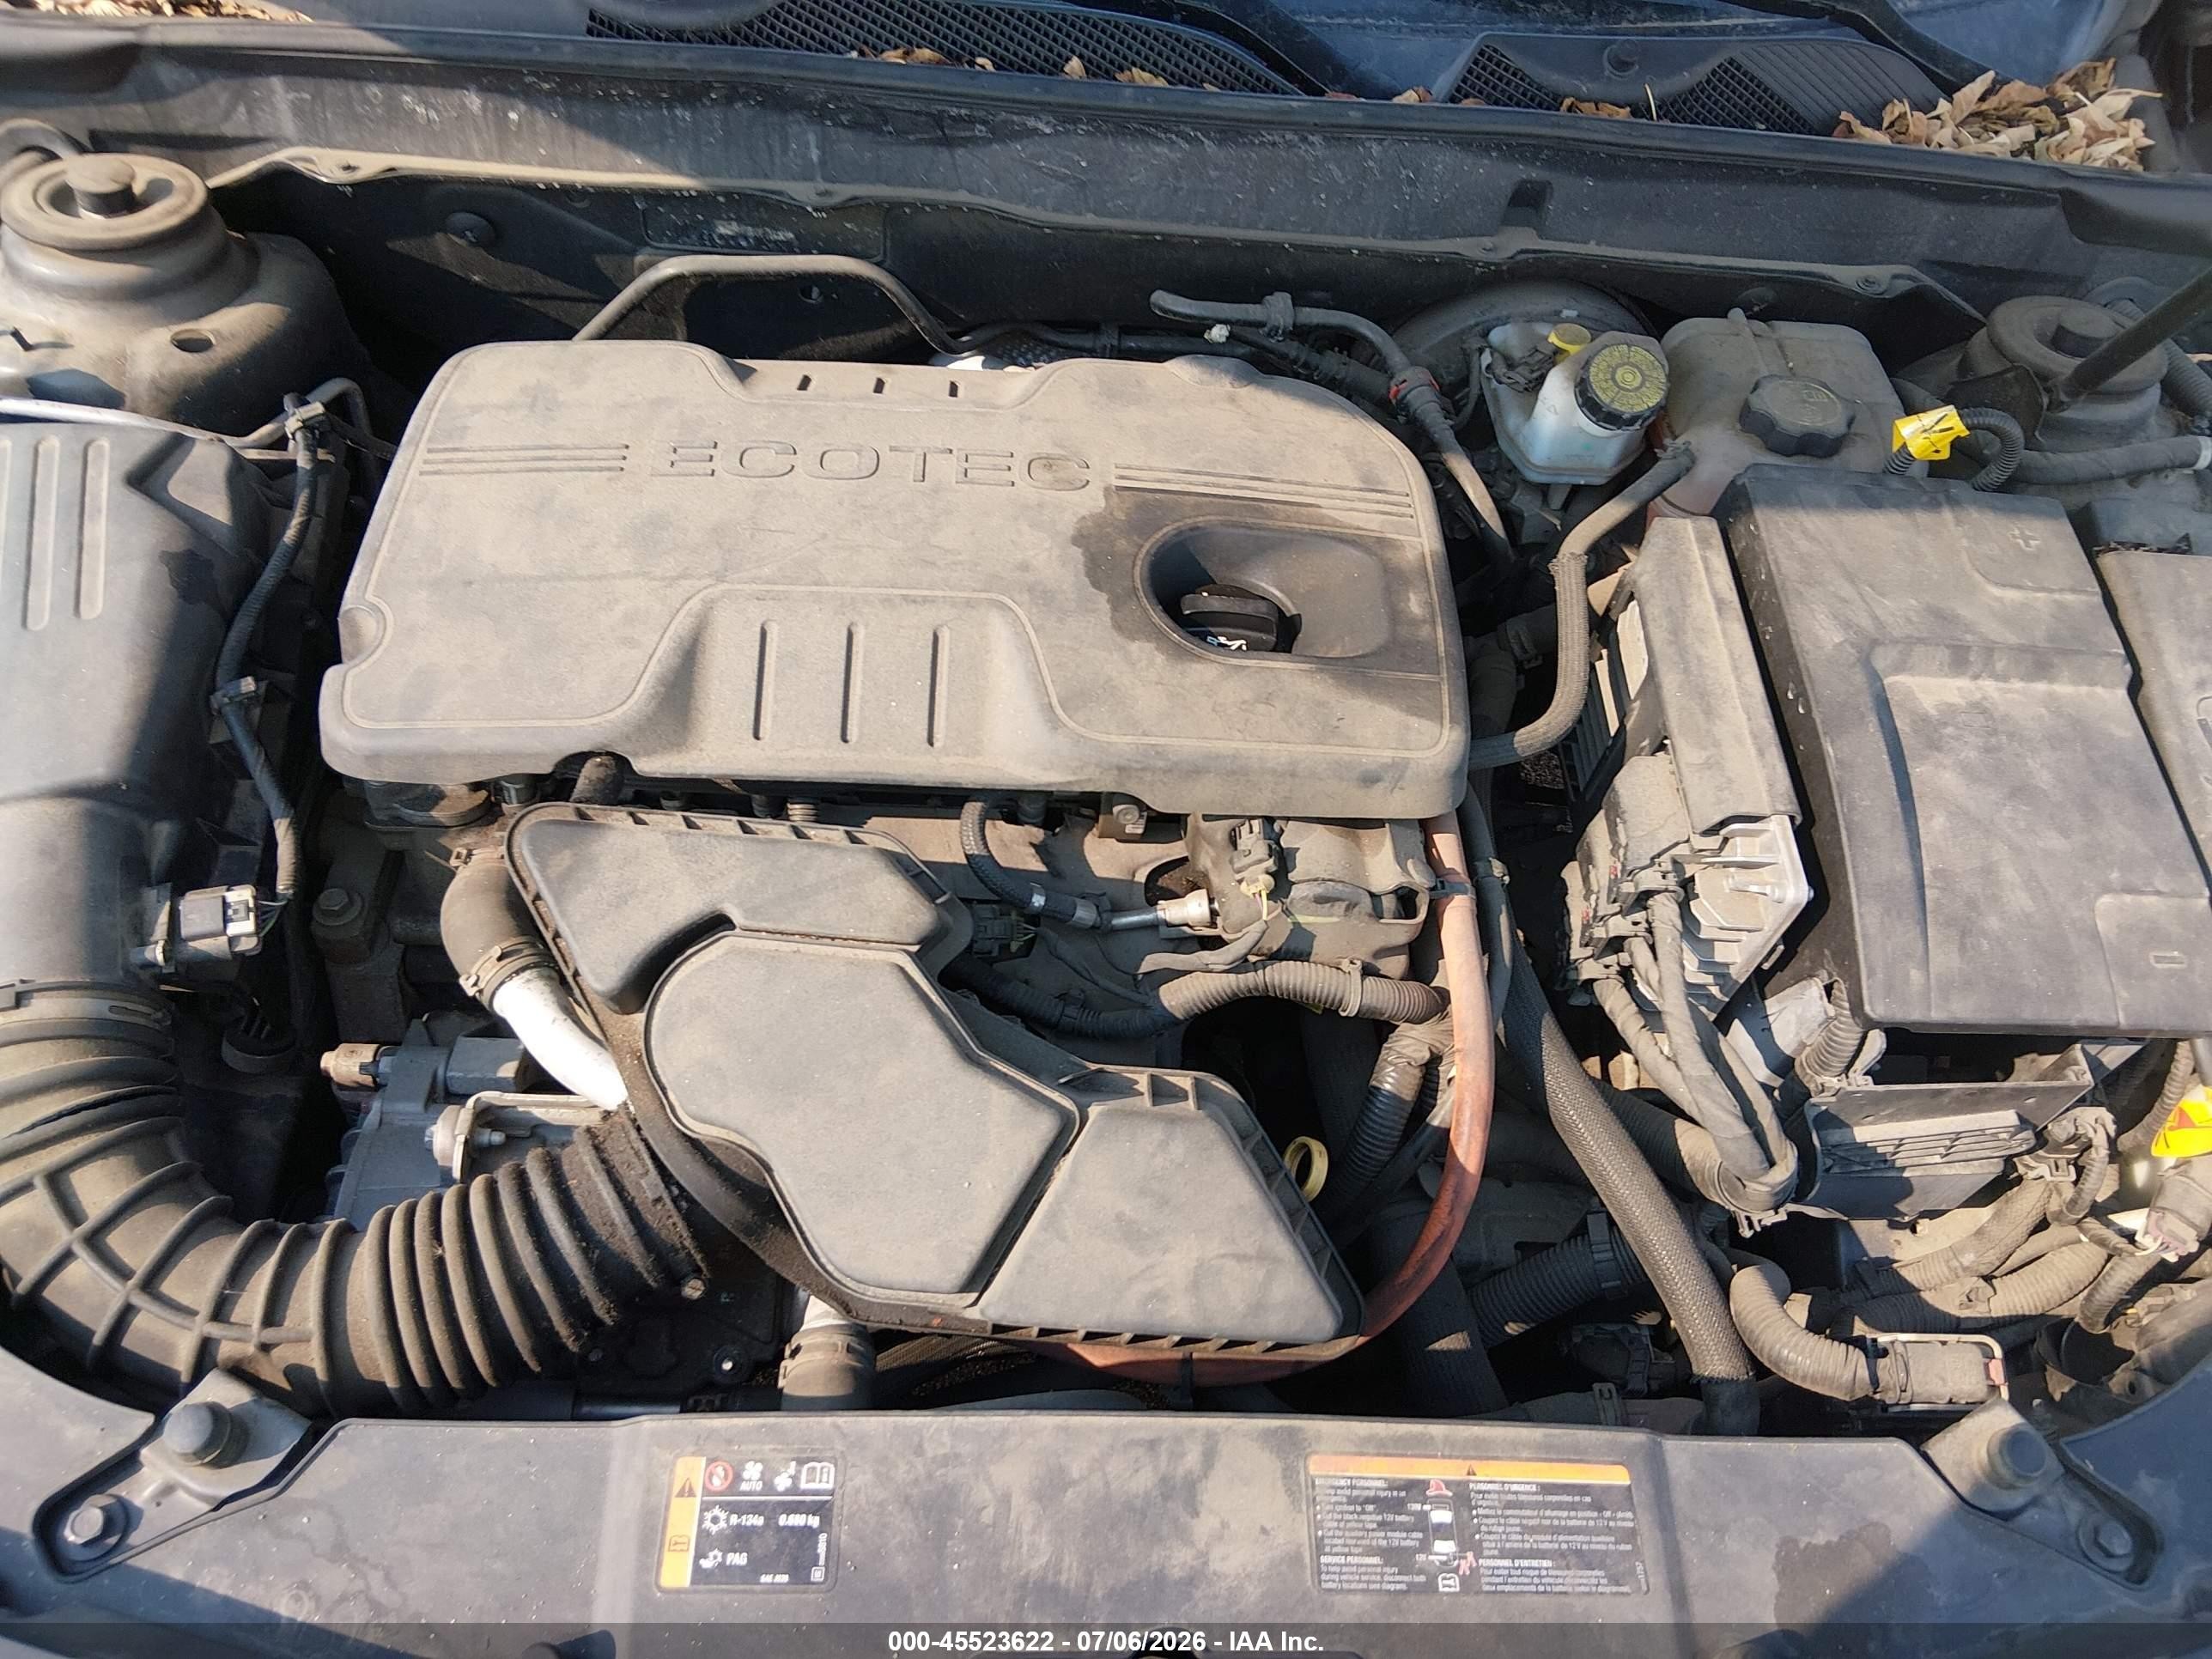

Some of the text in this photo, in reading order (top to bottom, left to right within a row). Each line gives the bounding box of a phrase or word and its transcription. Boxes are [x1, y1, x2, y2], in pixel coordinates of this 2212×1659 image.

[651, 440, 1090, 491] ECOTEC
[740, 1480, 763, 1491] AUTO
[726, 1552, 748, 1565] PAG
